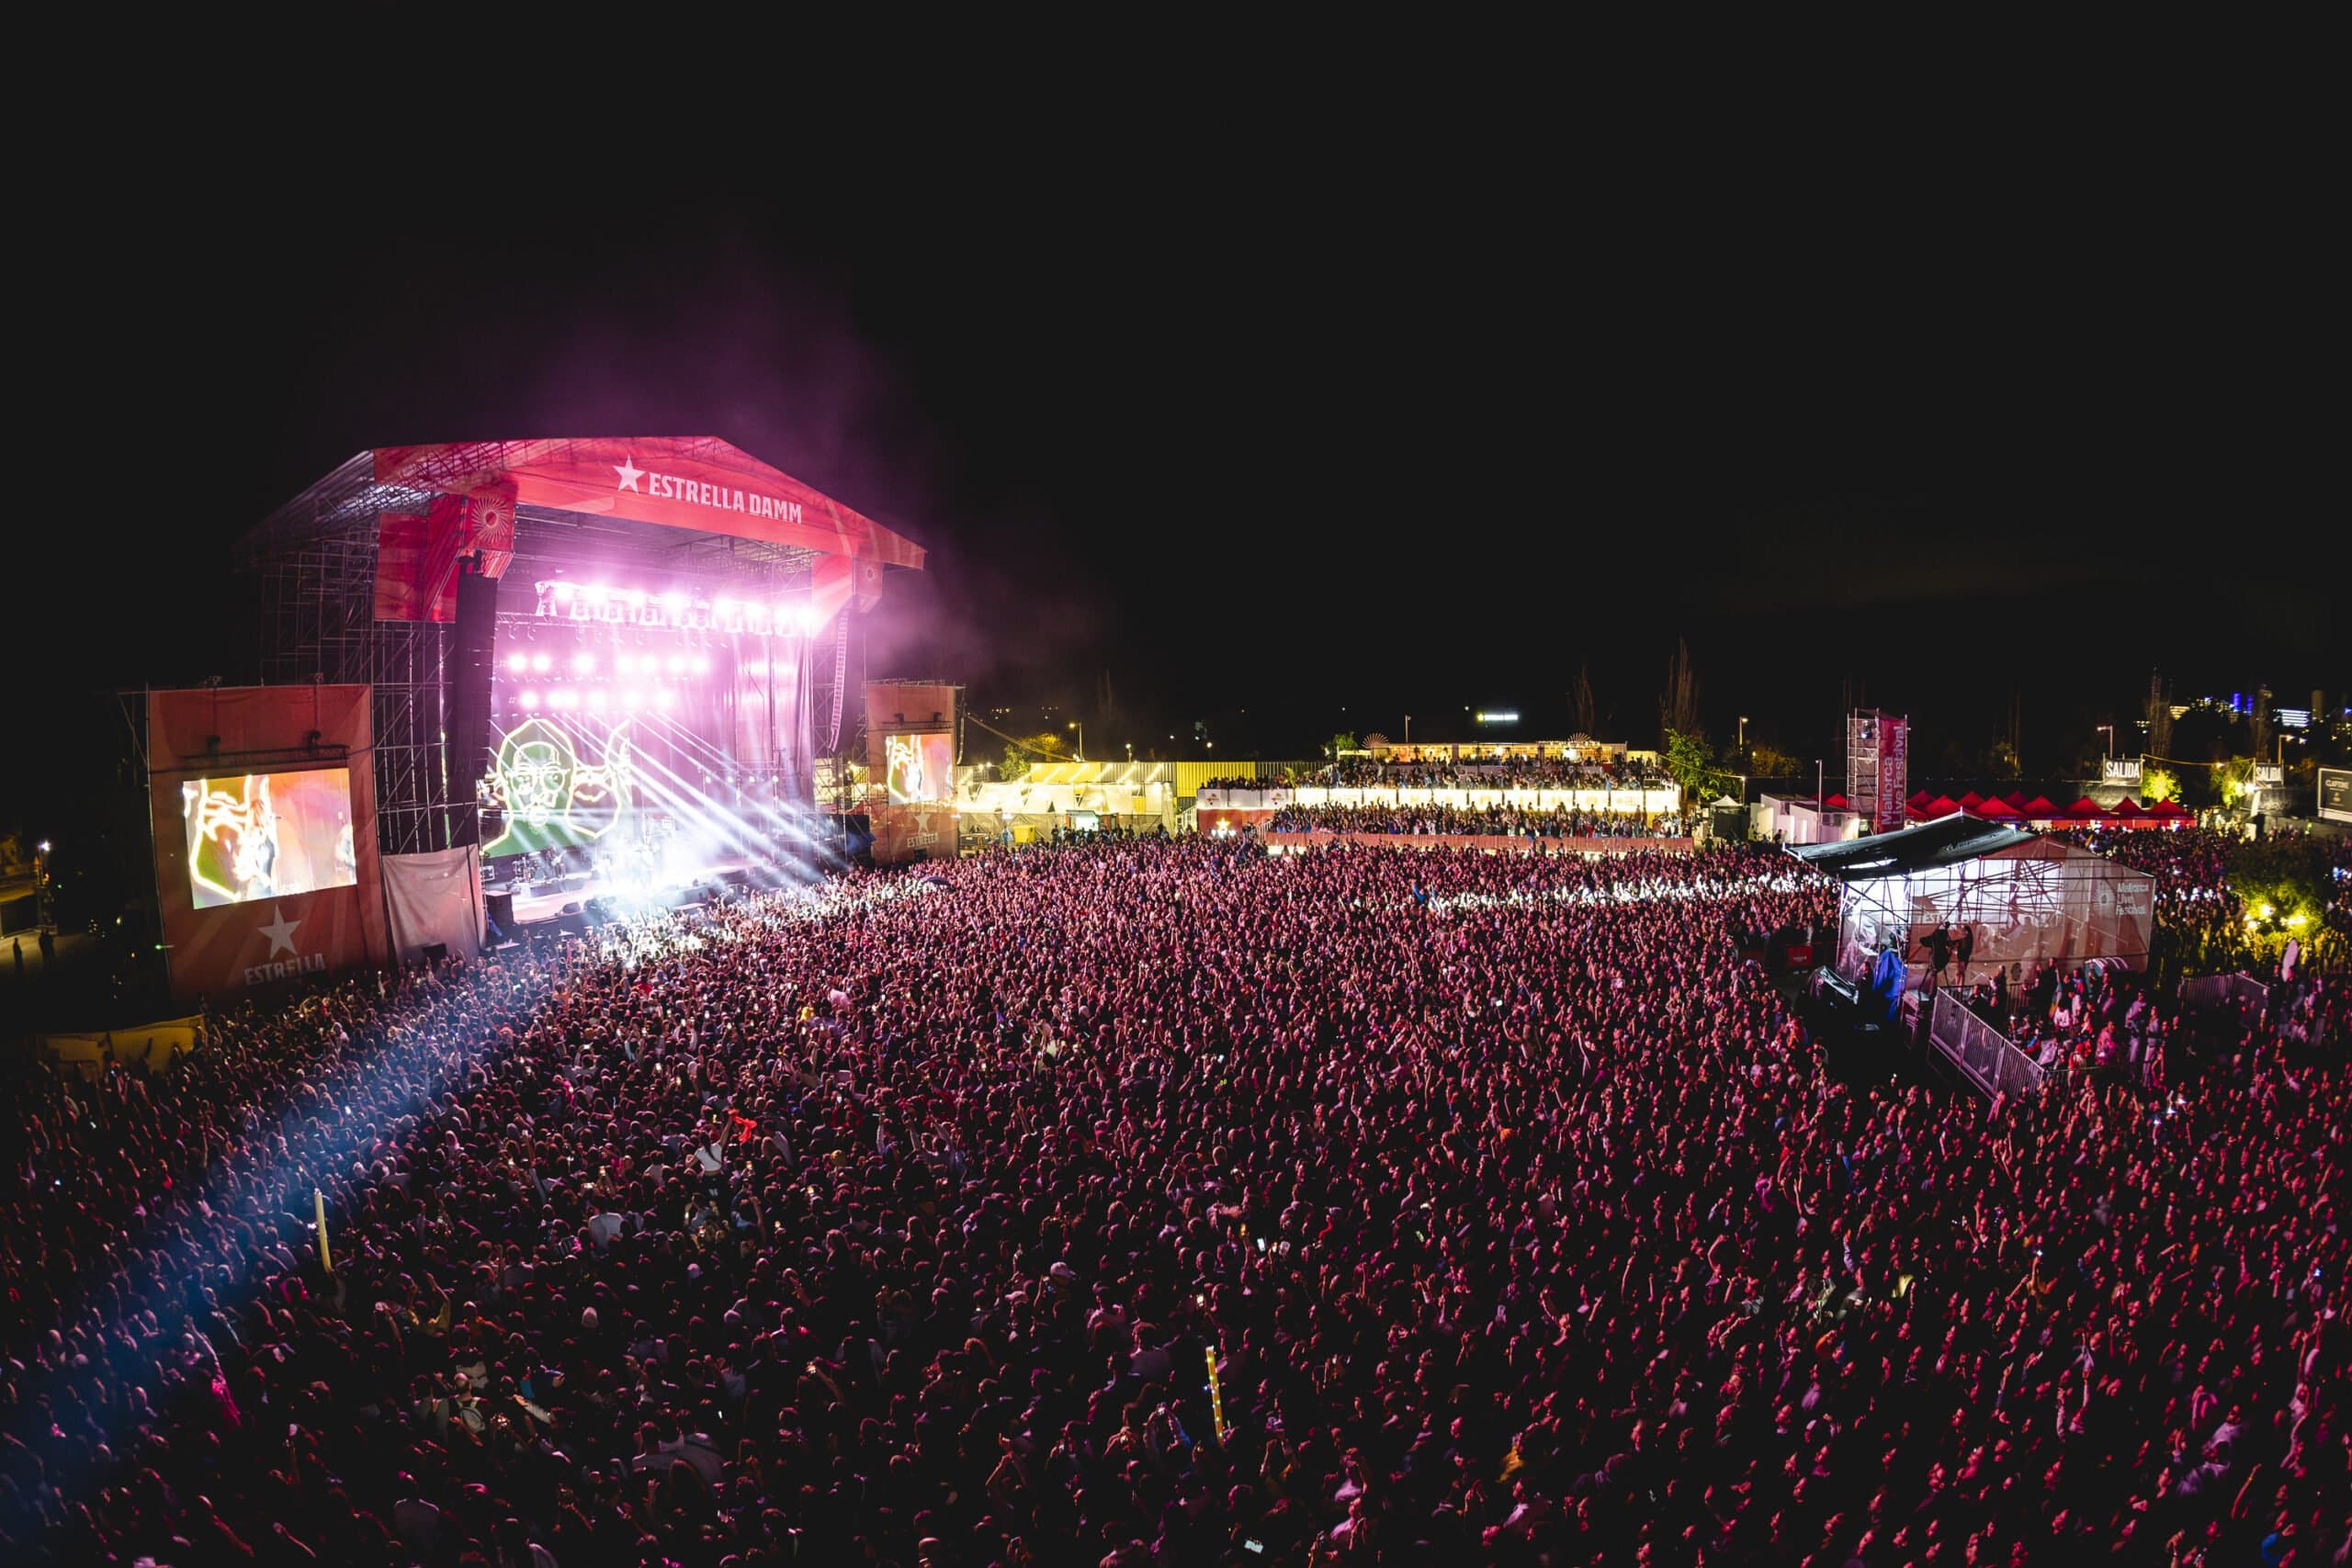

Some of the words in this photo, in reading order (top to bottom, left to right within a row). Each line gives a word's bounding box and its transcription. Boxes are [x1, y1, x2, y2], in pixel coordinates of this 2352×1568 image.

[649, 471, 745, 513] ESTRELLA
[749, 493, 802, 525] DAMM
[2105, 761, 2141, 779] SALIDA
[2256, 765, 2282, 782] SALIDA
[1882, 756, 1893, 826] Mallorca
[1893, 790, 1905, 825] Live
[907, 831, 940, 848] ESTRELLA
[243, 953, 327, 986] ESTRELLA
